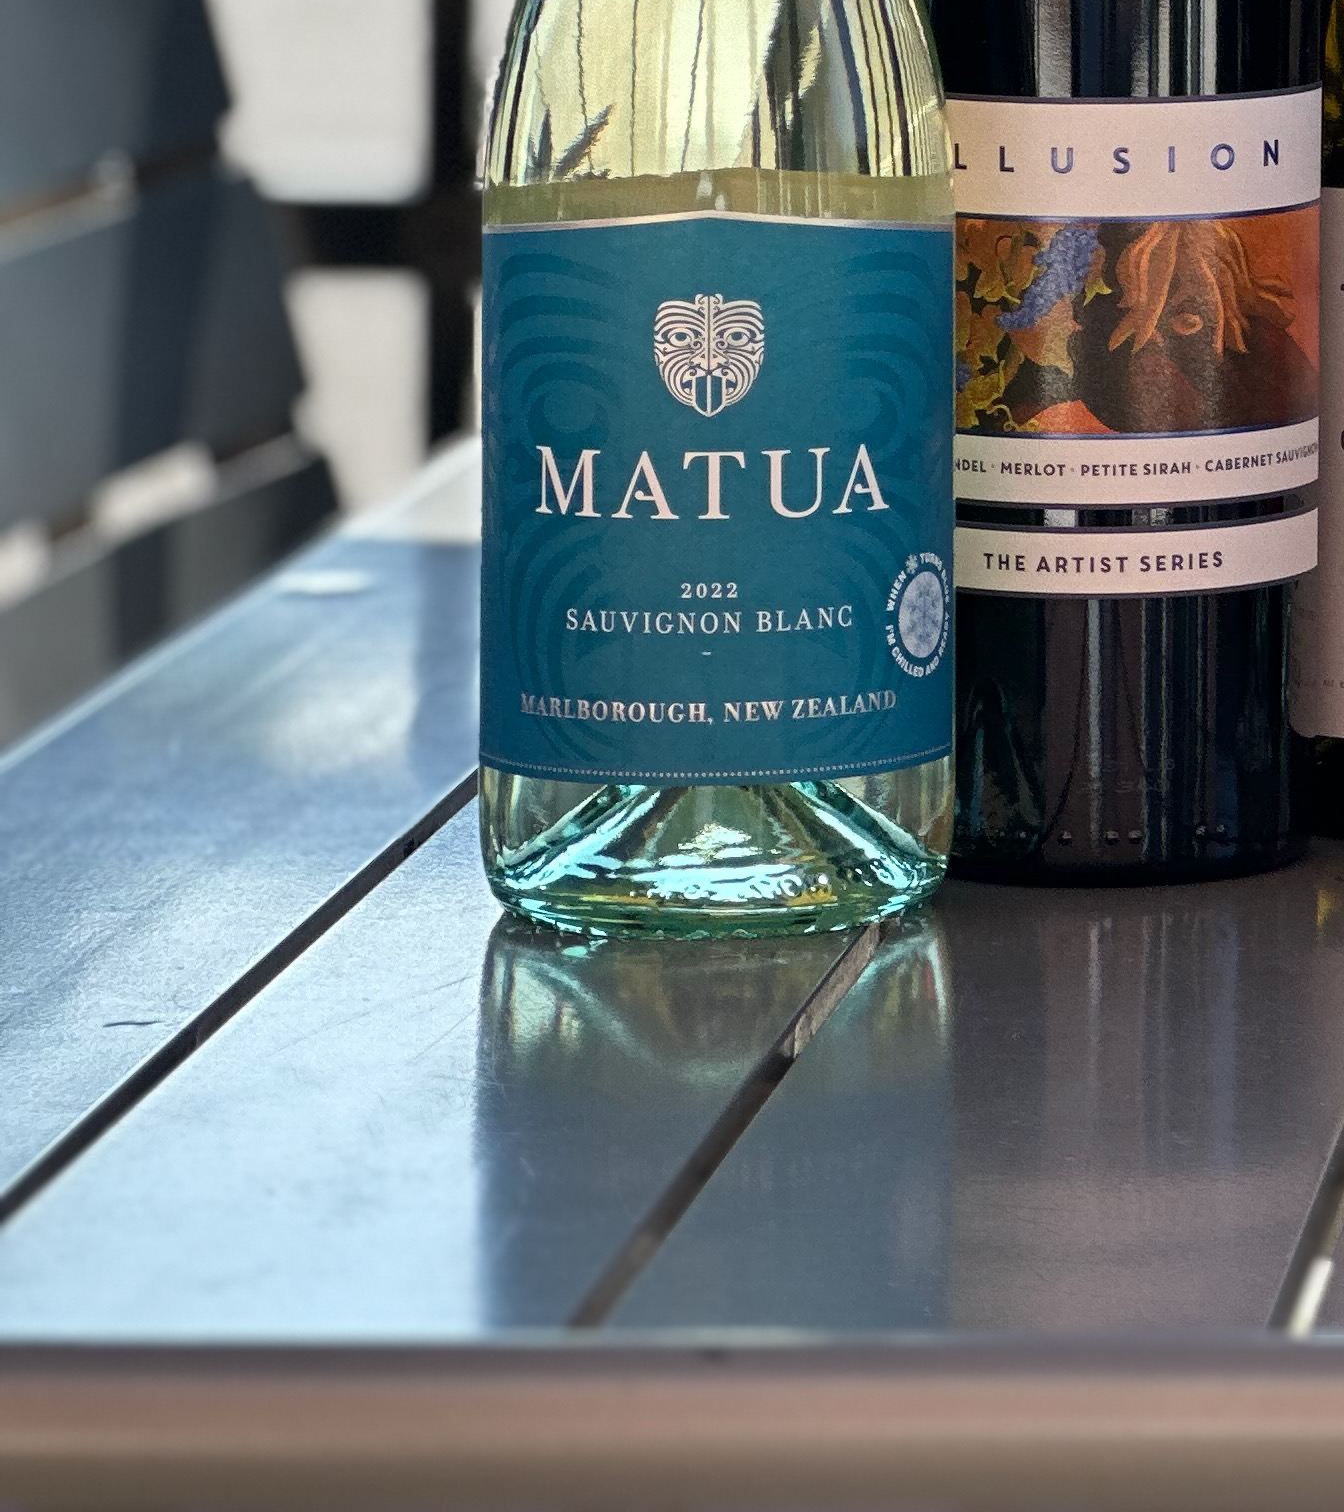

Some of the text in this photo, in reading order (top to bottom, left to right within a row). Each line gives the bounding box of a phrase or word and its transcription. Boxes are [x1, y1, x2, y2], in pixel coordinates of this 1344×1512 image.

[1000, 461, 1067, 477] MERLOT
[1080, 463, 1138, 477] PETITE
[1143, 461, 1192, 476] SIRAH
[1204, 452, 1273, 473] CABERNET
[535, 443, 889, 520] MATUA
[983, 550, 1224, 575] THE ARTIST SERIES
[680, 581, 739, 600] 2022
[565, 604, 855, 635] SAUVIGNON BLANC
[519, 690, 898, 726] MARLBOROUGH, NEW ZEALAND
